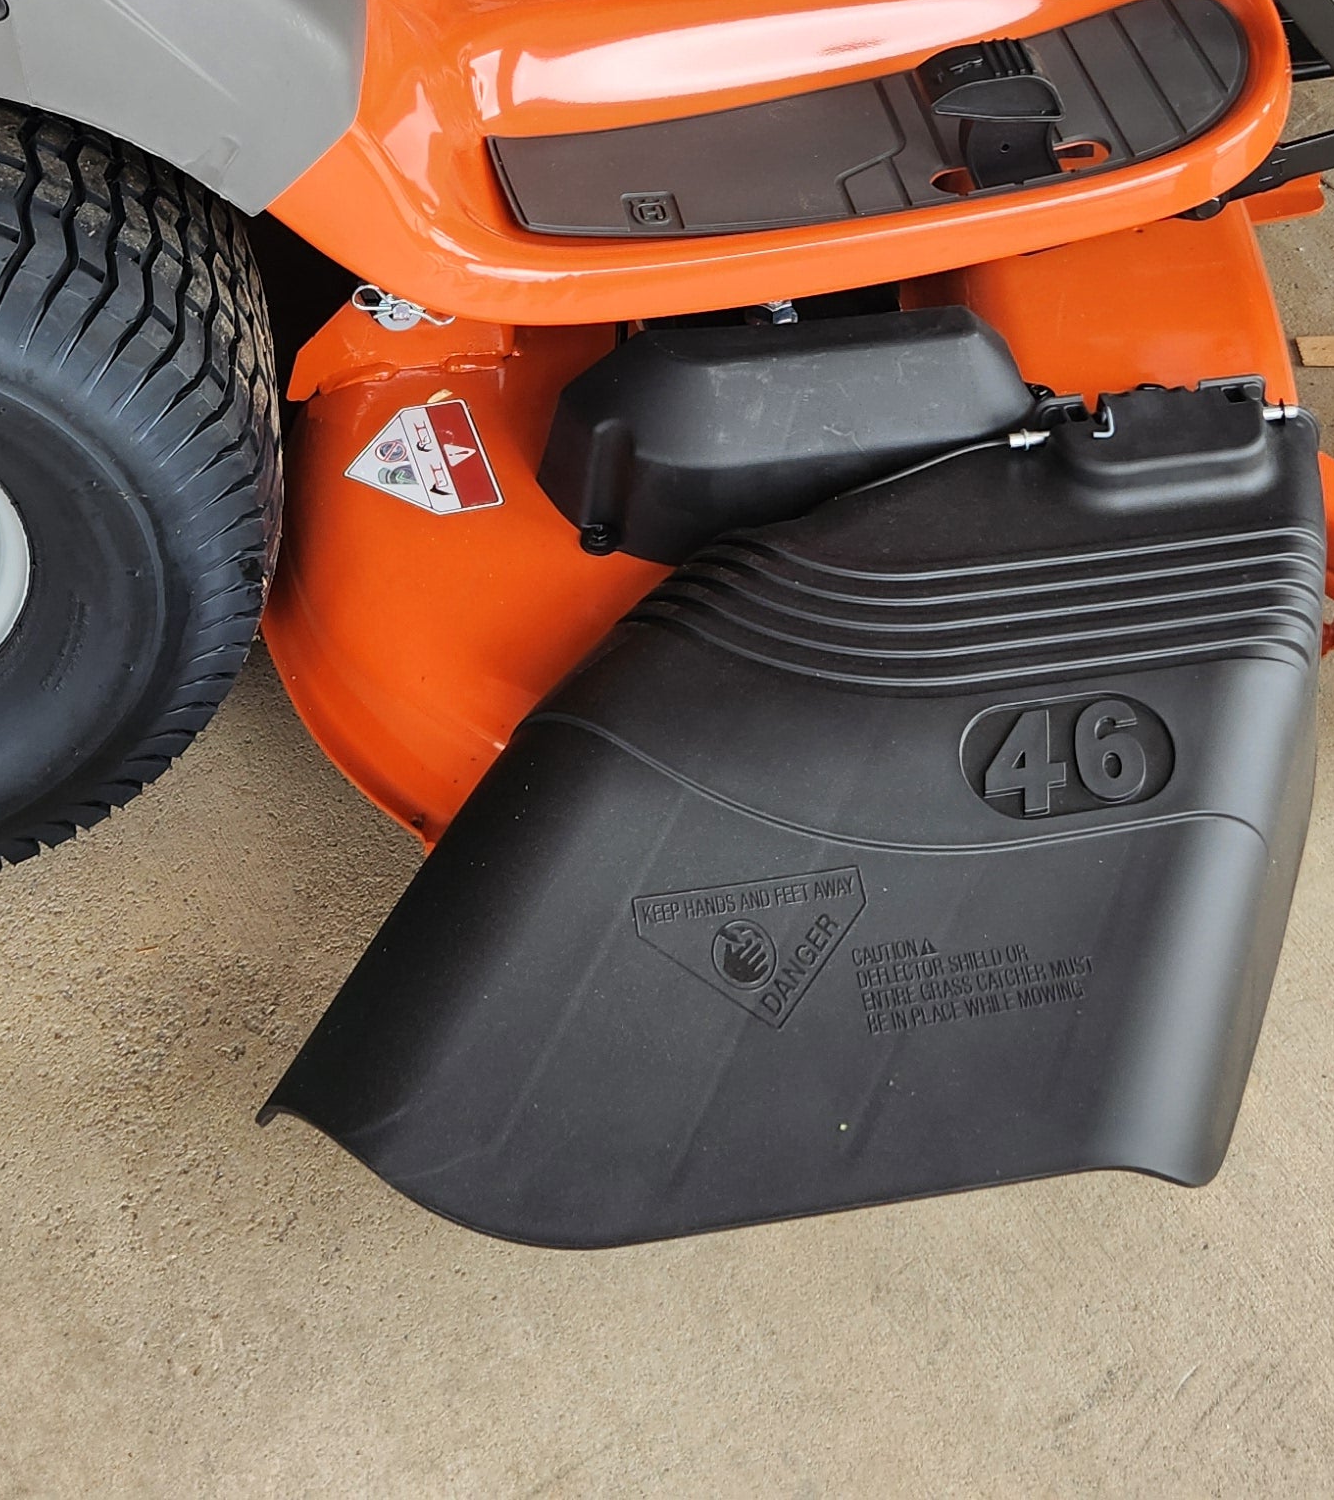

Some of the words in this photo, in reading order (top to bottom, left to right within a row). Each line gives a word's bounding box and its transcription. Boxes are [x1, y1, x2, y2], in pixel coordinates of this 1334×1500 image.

[983, 699, 1147, 818] 46
[641, 900, 680, 925] KEEP
[684, 894, 737, 920] HANDS
[740, 890, 771, 914] AND
[775, 884, 810, 909] FEET
[814, 875, 856, 901] AWAY
[760, 912, 840, 1017] DANGER
[851, 942, 920, 967] CAUTION
[856, 955, 946, 988] DEFLECTOR
[947, 948, 1003, 976] SHIELD
[1006, 943, 1030, 964] OR
[861, 985, 918, 1012] ENTIRE
[921, 977, 971, 1002] GRASS
[974, 965, 1049, 995] CATCHER
[1051, 955, 1095, 979] MUST
[867, 1012, 890, 1035] BE
[893, 1011, 911, 1032] IN
[914, 1002, 964, 1028] PLACE
[965, 993, 1016, 1019] WHILE
[1017, 980, 1086, 1010] MOWING
